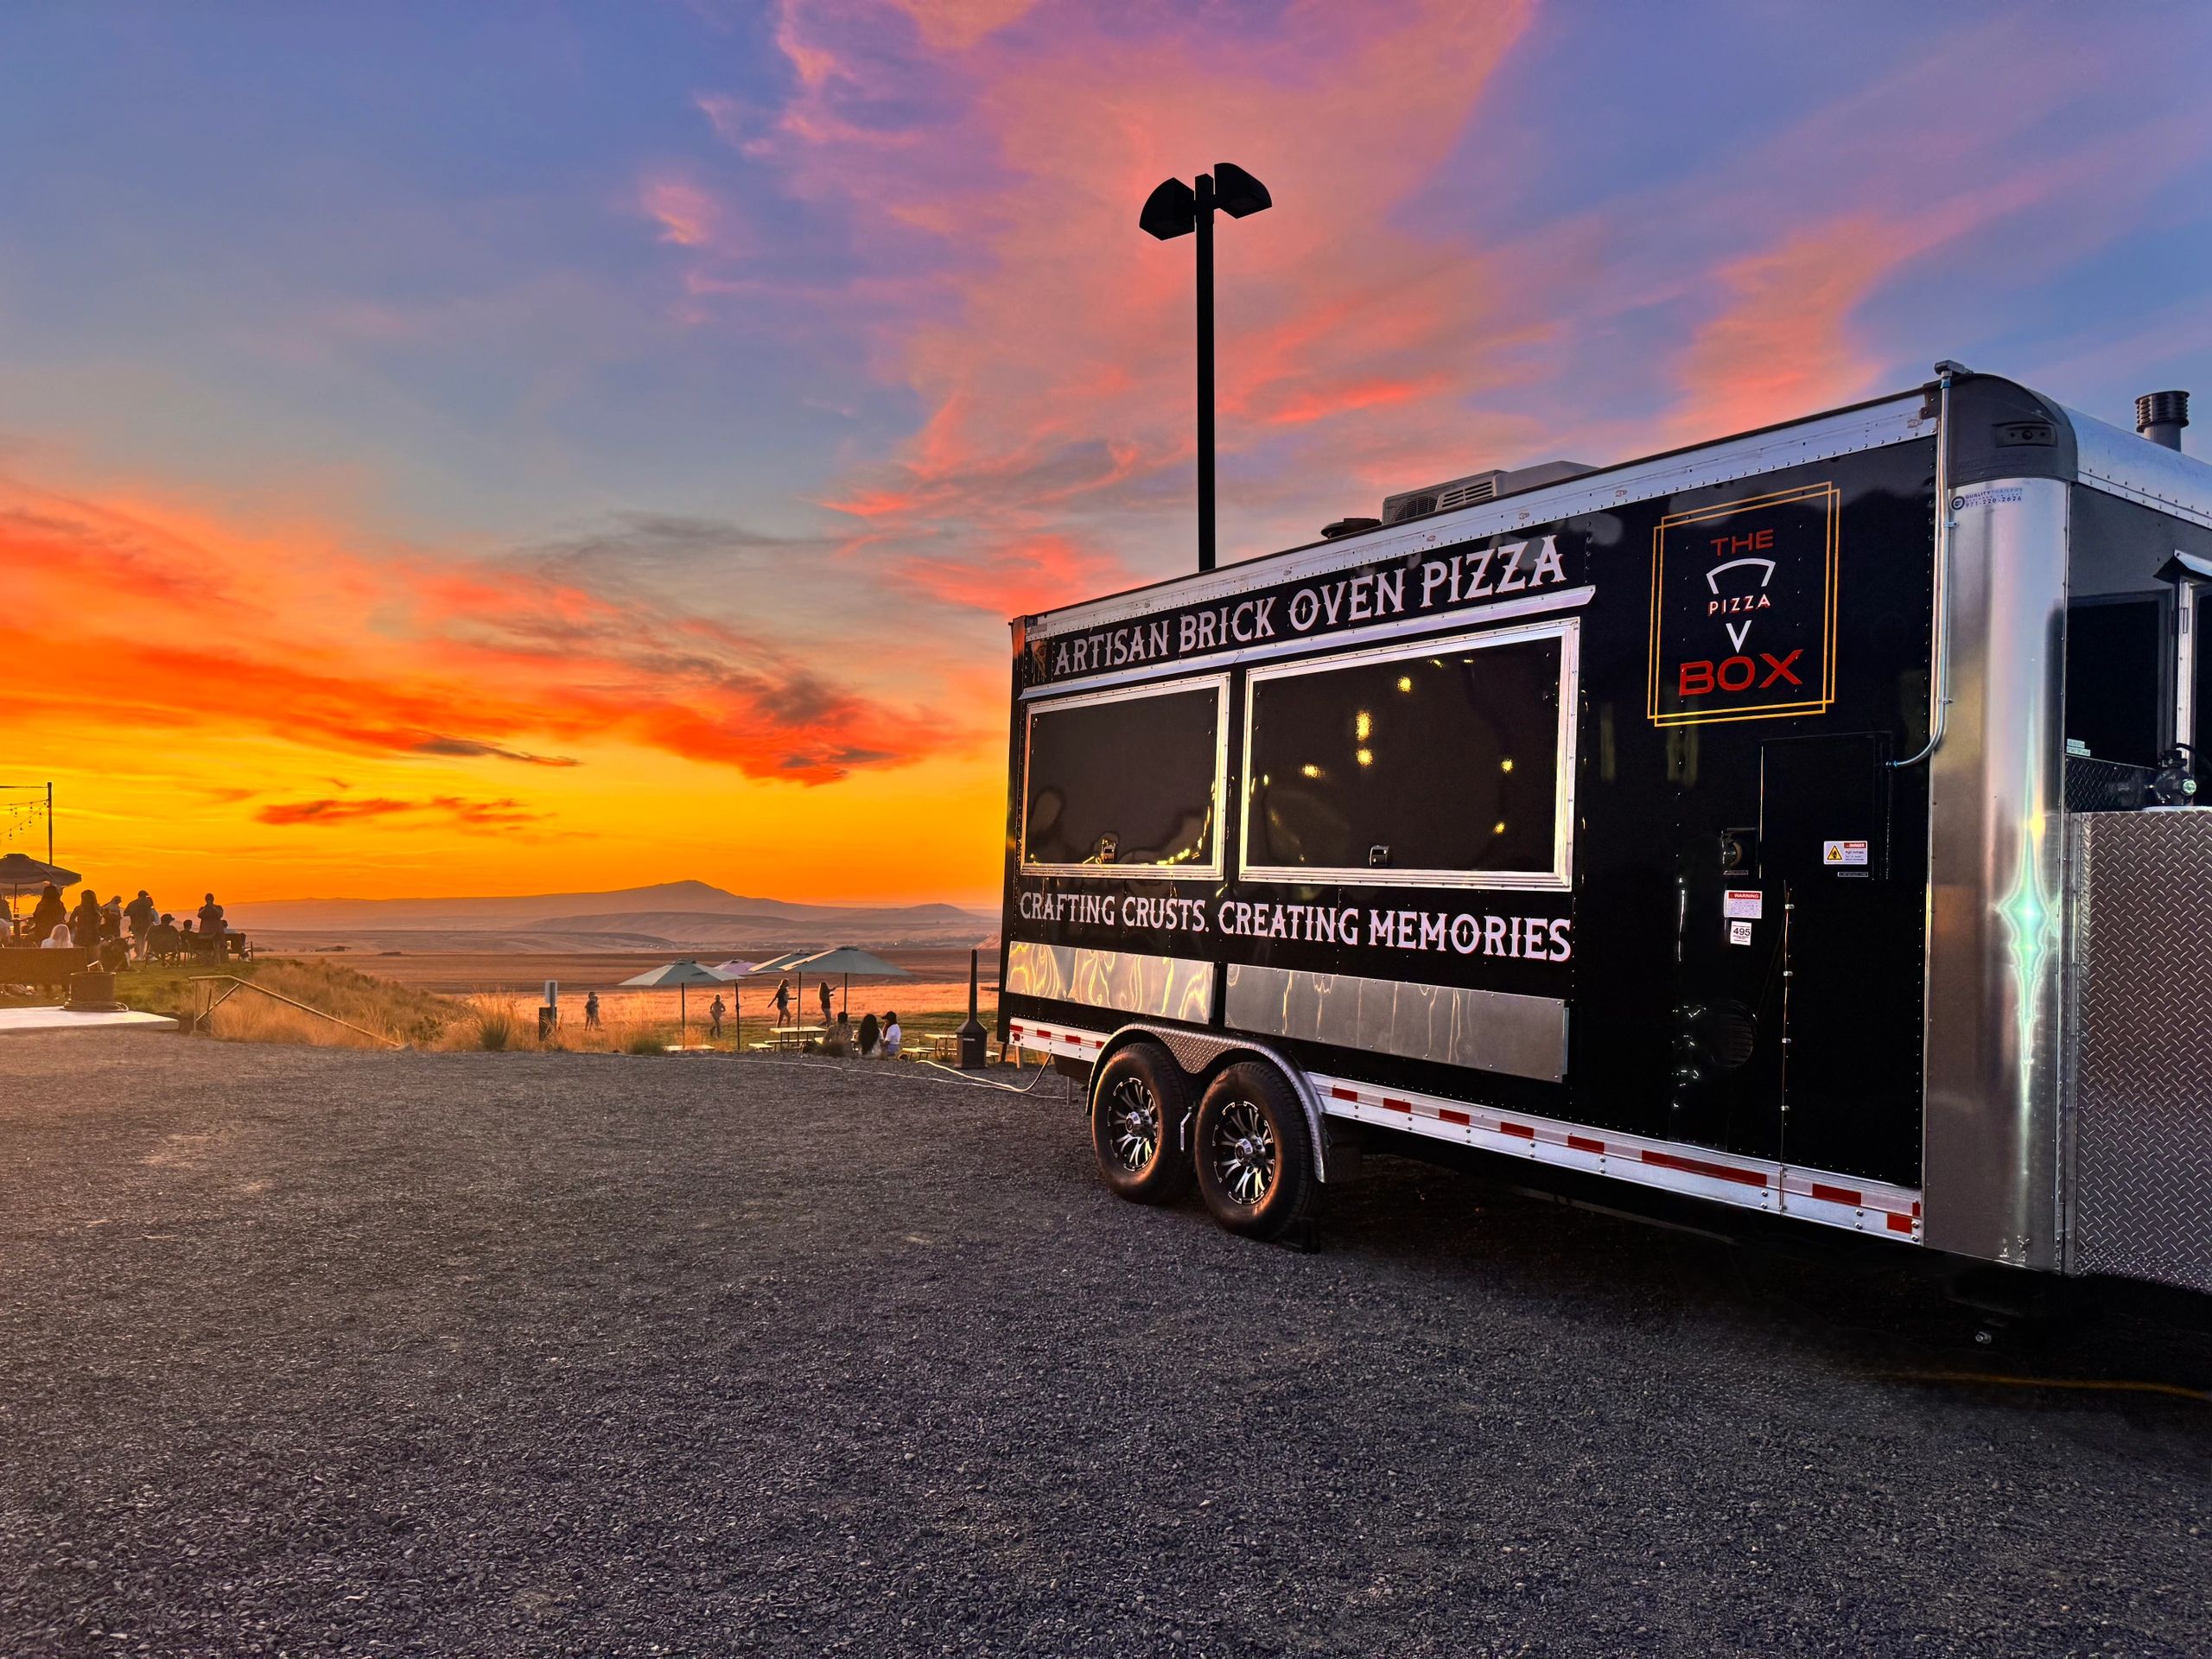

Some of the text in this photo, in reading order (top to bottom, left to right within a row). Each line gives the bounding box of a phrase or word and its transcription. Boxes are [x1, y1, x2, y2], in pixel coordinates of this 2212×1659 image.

[1710, 529, 1774, 556] THE
[1053, 535, 1567, 676] ARTISAN BRICK OVEN PIZZA
[1707, 594, 1771, 617] PIZZA
[1679, 649, 1804, 696] BOX
[1019, 892, 1116, 926] CRAFTING
[1217, 900, 1359, 946] CREATING
[1368, 909, 1572, 963] MEMORIES
[1732, 927, 1751, 937] 495
